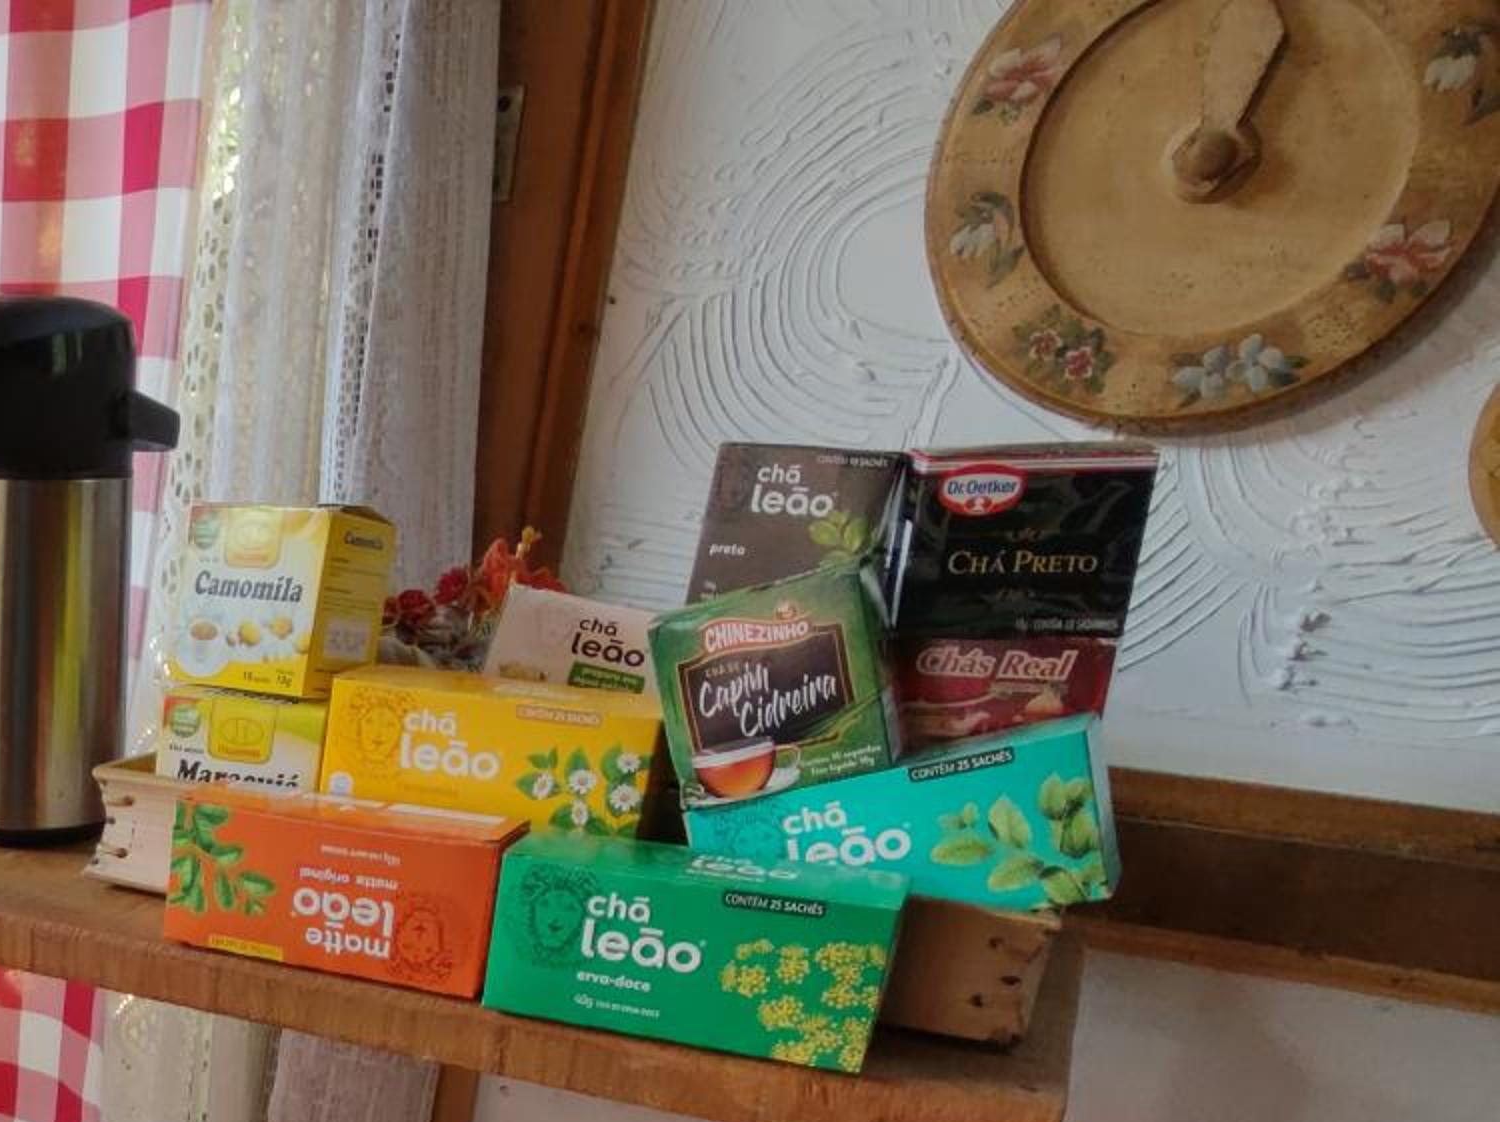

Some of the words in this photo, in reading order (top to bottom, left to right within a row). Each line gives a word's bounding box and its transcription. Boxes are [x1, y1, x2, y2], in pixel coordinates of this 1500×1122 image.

[751, 484, 835, 517] leão
[948, 549, 1005, 574] CHÁ
[1012, 549, 1098, 573] PRETO
[195, 570, 303, 603] Camomila
[571, 632, 645, 667] leão
[705, 620, 810, 652] CHINEZINHO
[997, 649, 1079, 681] Real
[699, 662, 770, 718] Capim
[739, 674, 837, 737] Cidreira
[401, 732, 501, 780] leão
[957, 760, 970, 770] 25
[787, 826, 911, 866] leão
[293, 887, 395, 939] leão
[769, 899, 782, 911] 25
[306, 927, 390, 959] matte
[580, 918, 702, 974] leão
[577, 971, 651, 993] erva-doce
